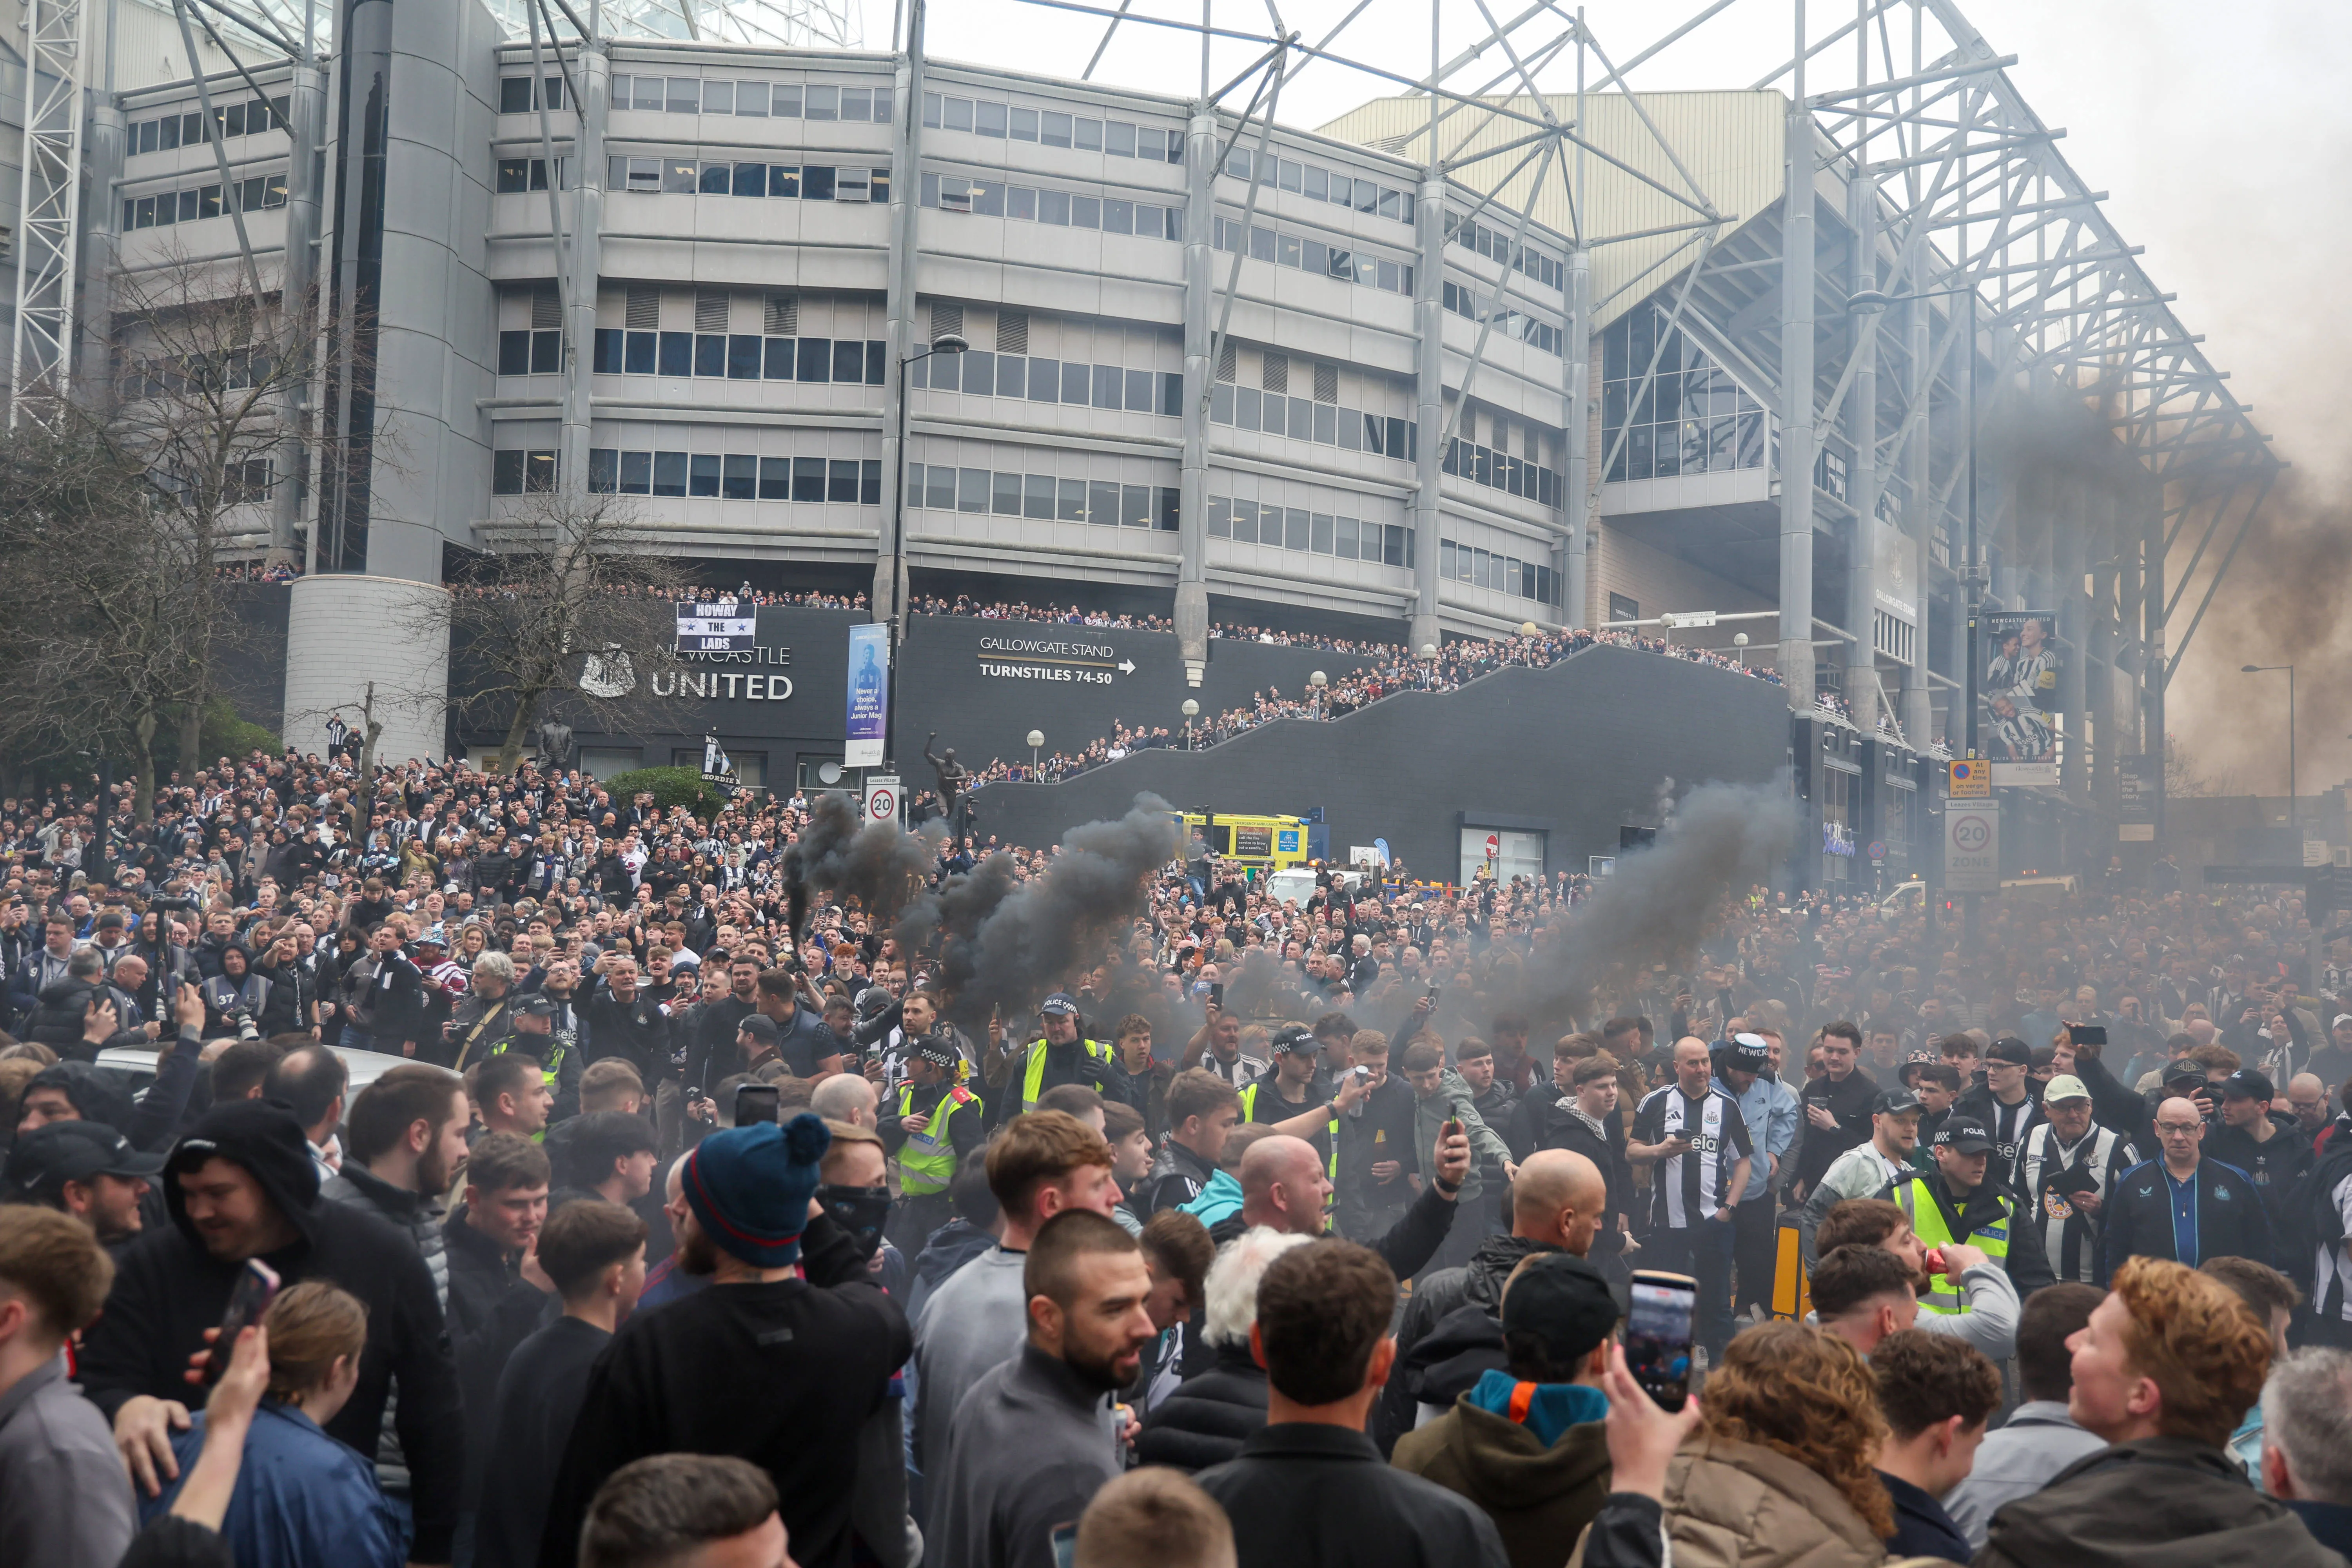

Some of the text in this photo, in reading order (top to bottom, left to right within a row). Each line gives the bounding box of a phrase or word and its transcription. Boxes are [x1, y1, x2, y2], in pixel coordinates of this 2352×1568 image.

[1876, 588, 1916, 617] GALLOWGATE STAND
[696, 604, 737, 617] HOWAY
[708, 622, 725, 632] THE
[701, 637, 730, 650] LADS
[980, 637, 1113, 658] GALLOWGATE STAND
[980, 664, 1112, 684] TURNSTILES 74-50
[652, 671, 793, 700] UNITED
[2020, 733, 2038, 746] sela
[702, 774, 734, 784] GEORDIE
[875, 799, 890, 811] 20
[1959, 827, 1985, 841] 20
[1952, 857, 1991, 867] ZONE
[218, 993, 234, 1005] 37
[1738, 1045, 1768, 1057] NEWCAS
[1963, 1127, 1986, 1136] POLICE
[1692, 1135, 1718, 1150] ela
[1996, 1142, 2018, 1159] sel
[2048, 1200, 2063, 1216] BROWN
